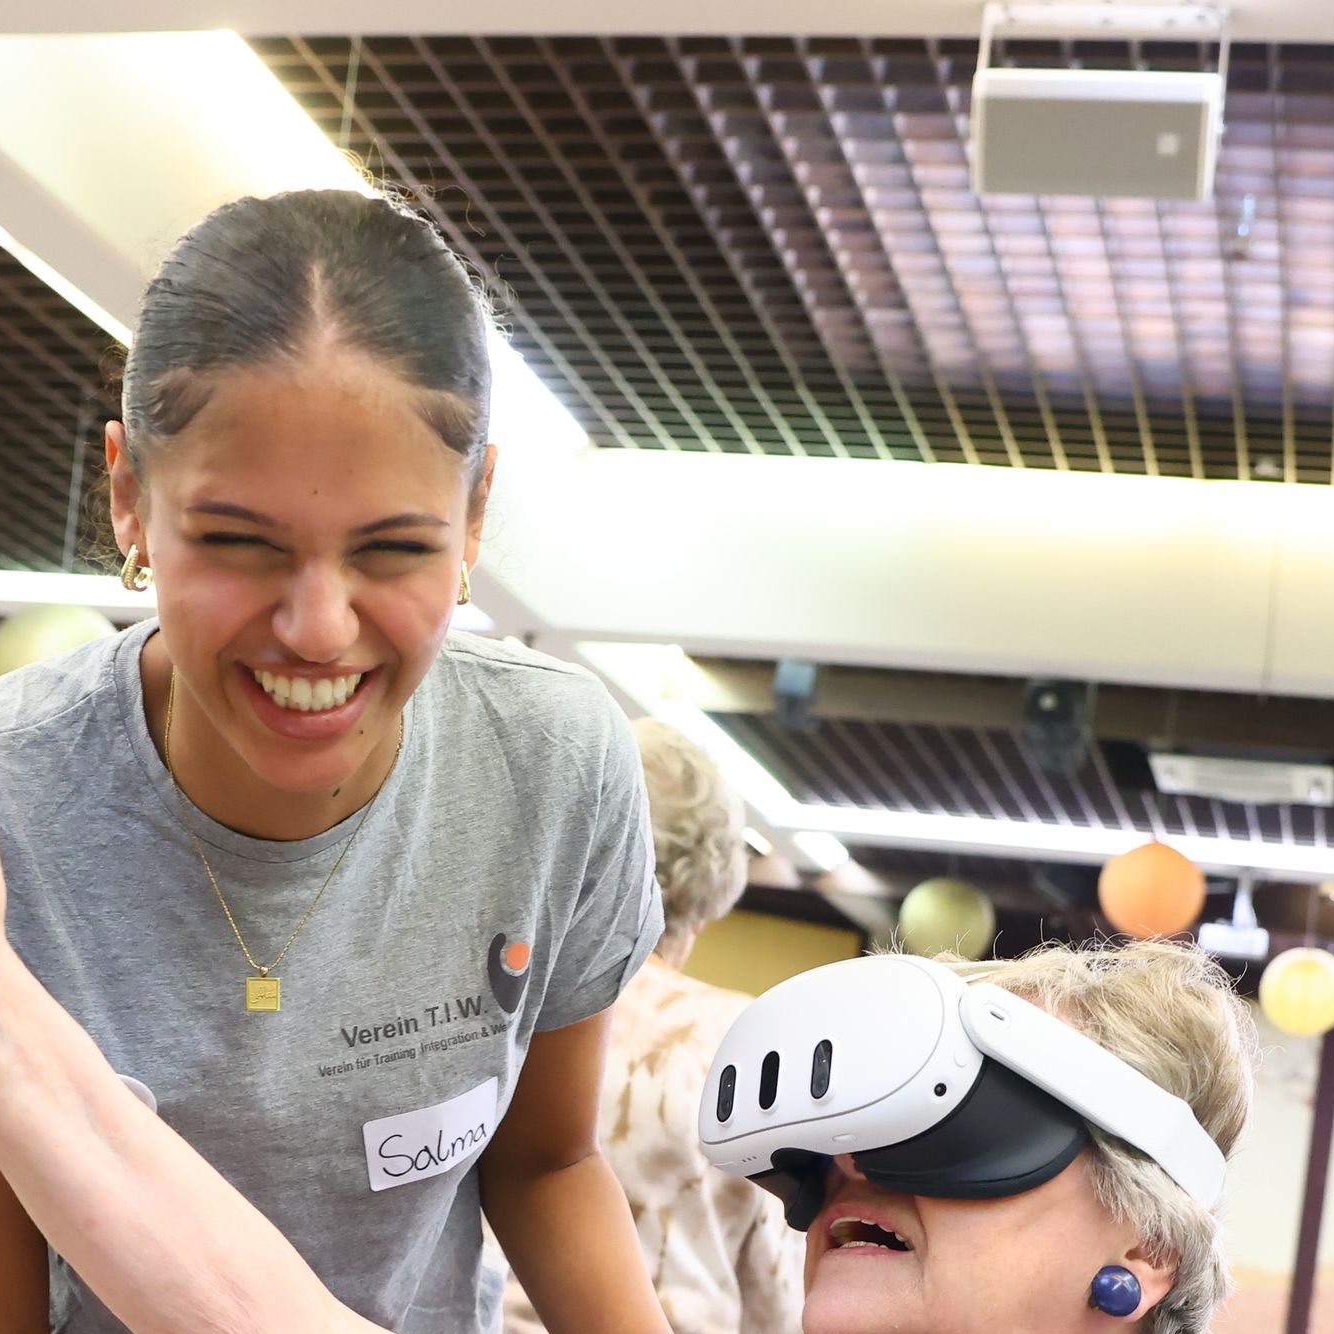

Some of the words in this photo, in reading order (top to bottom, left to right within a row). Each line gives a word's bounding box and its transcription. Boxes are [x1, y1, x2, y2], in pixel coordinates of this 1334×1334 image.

[340, 1016, 418, 1048] Verein
[424, 996, 488, 1027] T.I.W.
[318, 1061, 354, 1077] Verein
[355, 1057, 371, 1070] für
[420, 1031, 478, 1054] Integration
[481, 1026, 489, 1038] &
[490, 1023, 509, 1036] We
[378, 1123, 487, 1177] Salma
